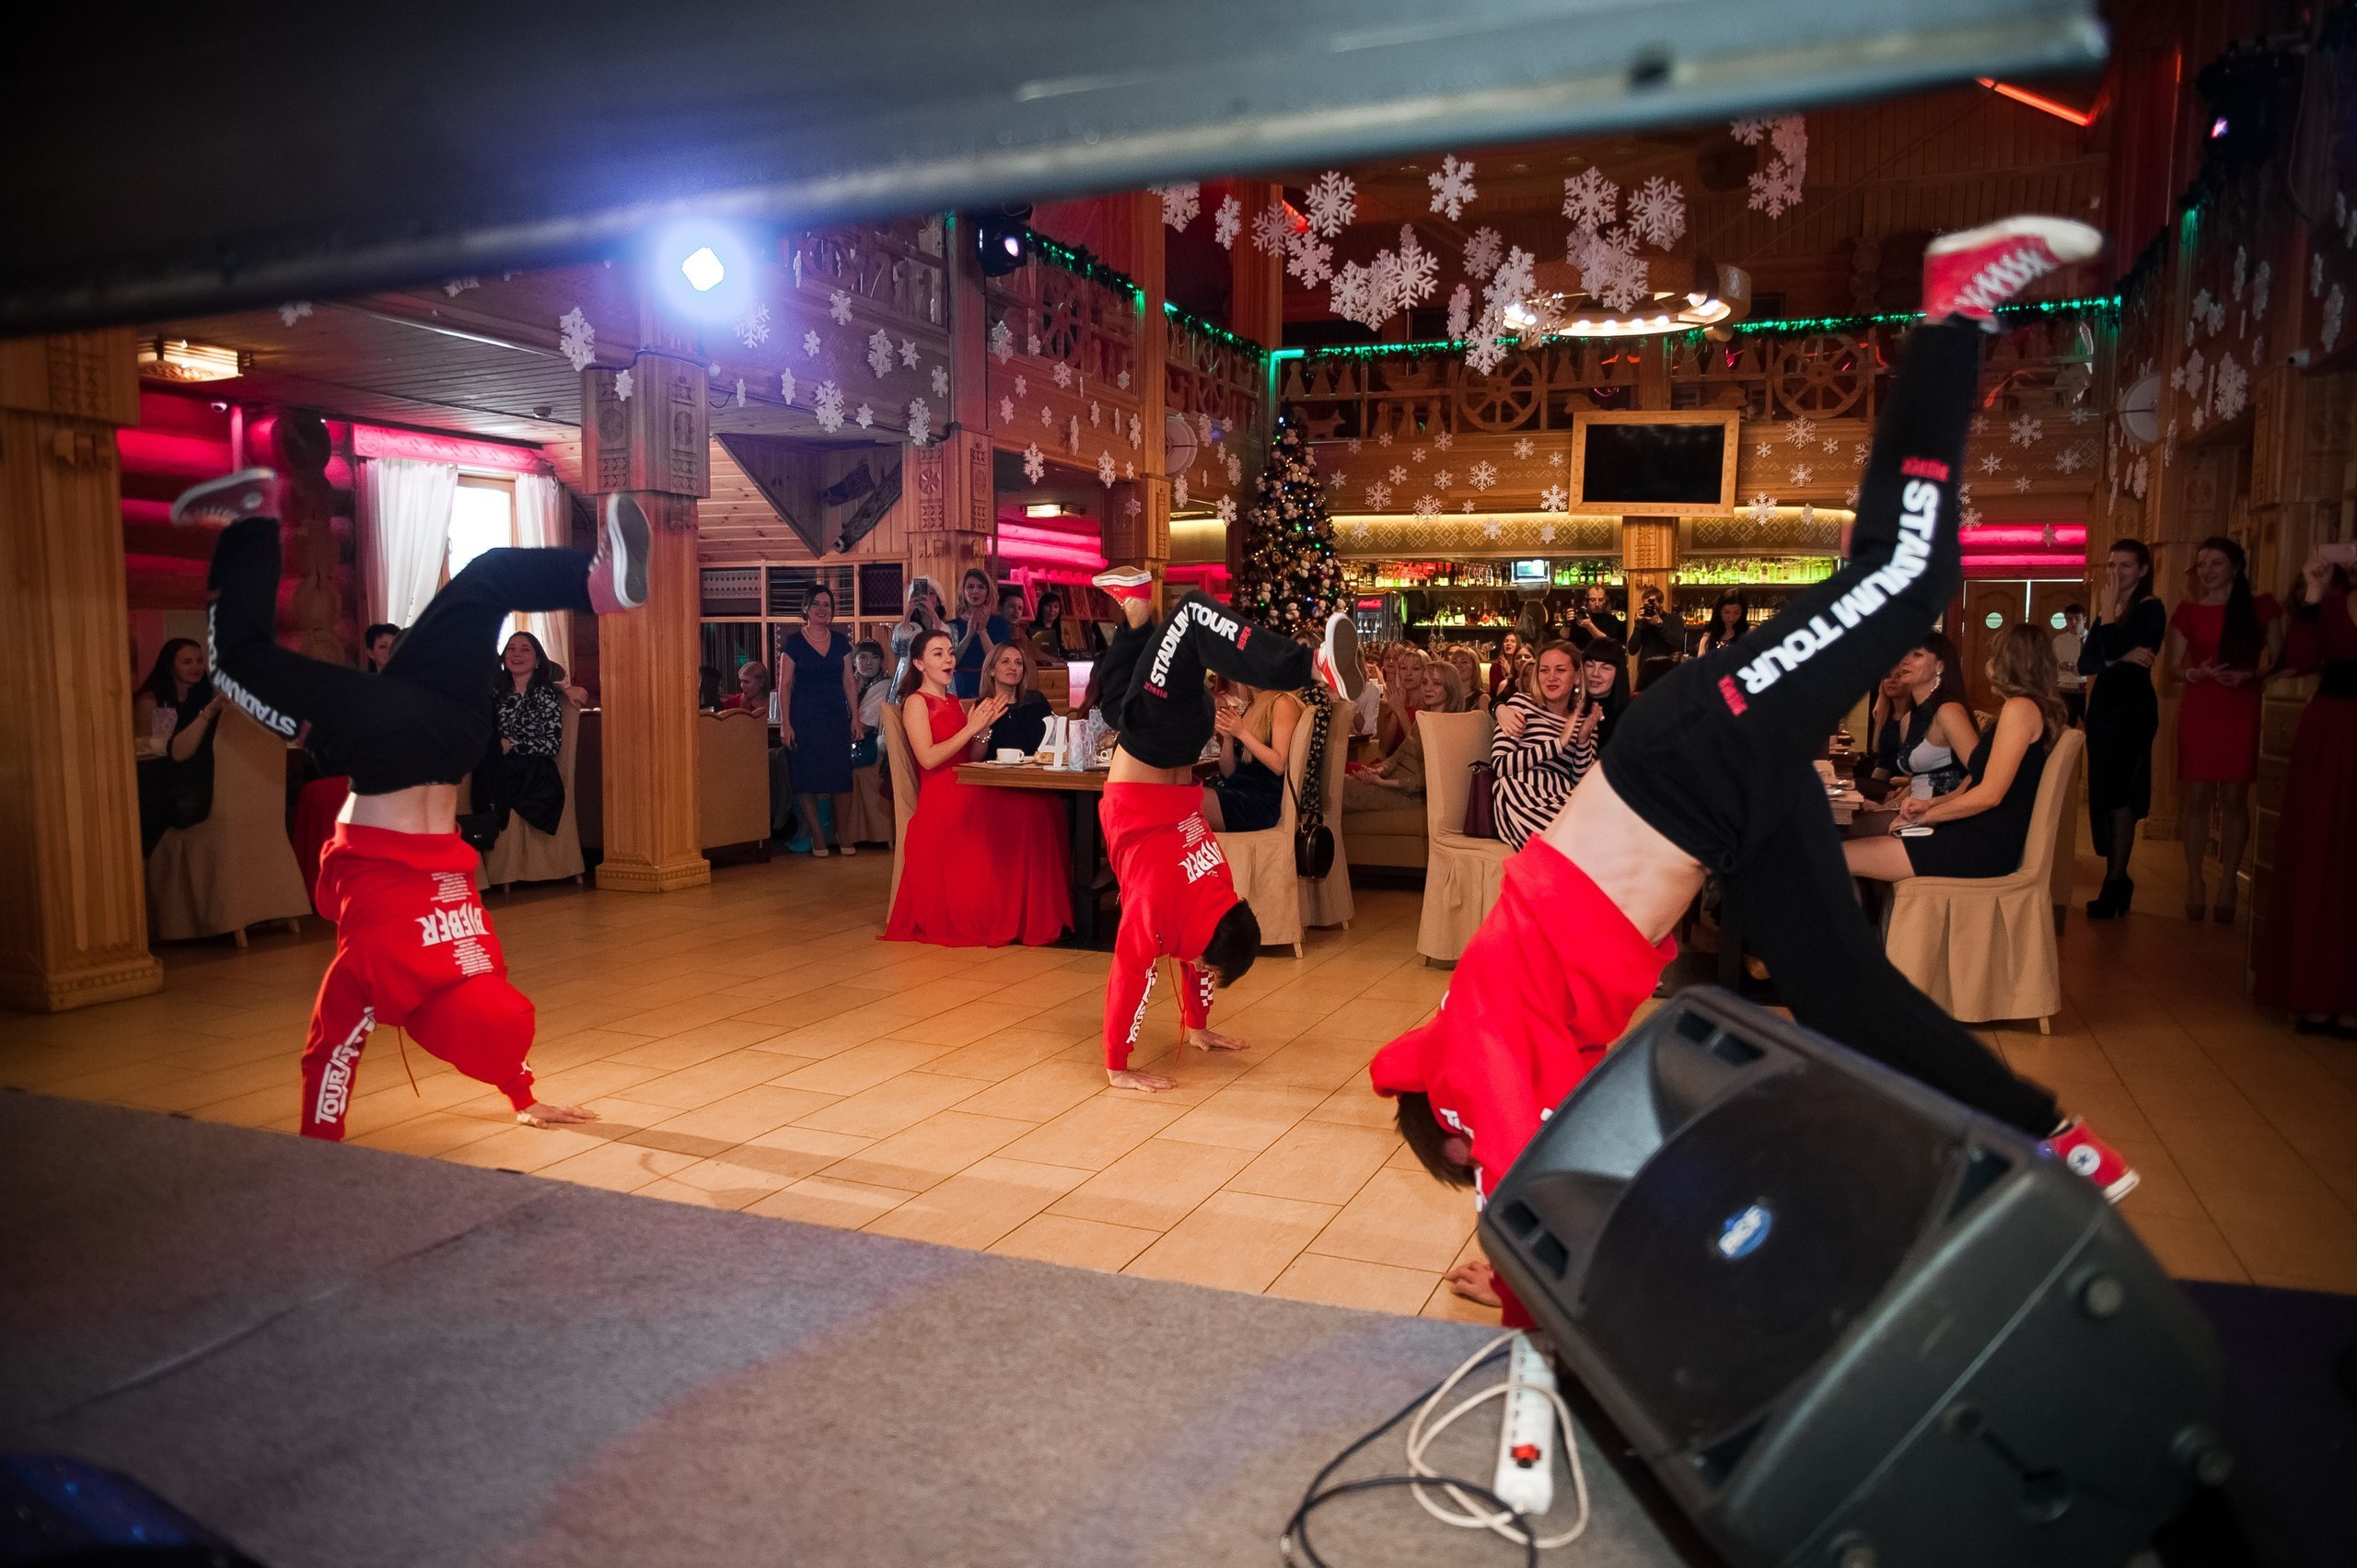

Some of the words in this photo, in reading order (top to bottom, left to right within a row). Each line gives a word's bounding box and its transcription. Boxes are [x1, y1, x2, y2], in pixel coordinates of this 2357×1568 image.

[1150, 604, 1190, 688] STADIUM
[1189, 601, 1238, 642] TOUR
[1736, 614, 1845, 694] TOUR
[213, 669, 296, 737] STADIUM
[1038, 716, 1068, 768] 4
[1178, 839, 1225, 884] BIEBER
[414, 902, 491, 947] BIEBER
[315, 1062, 347, 1124] TOUR
